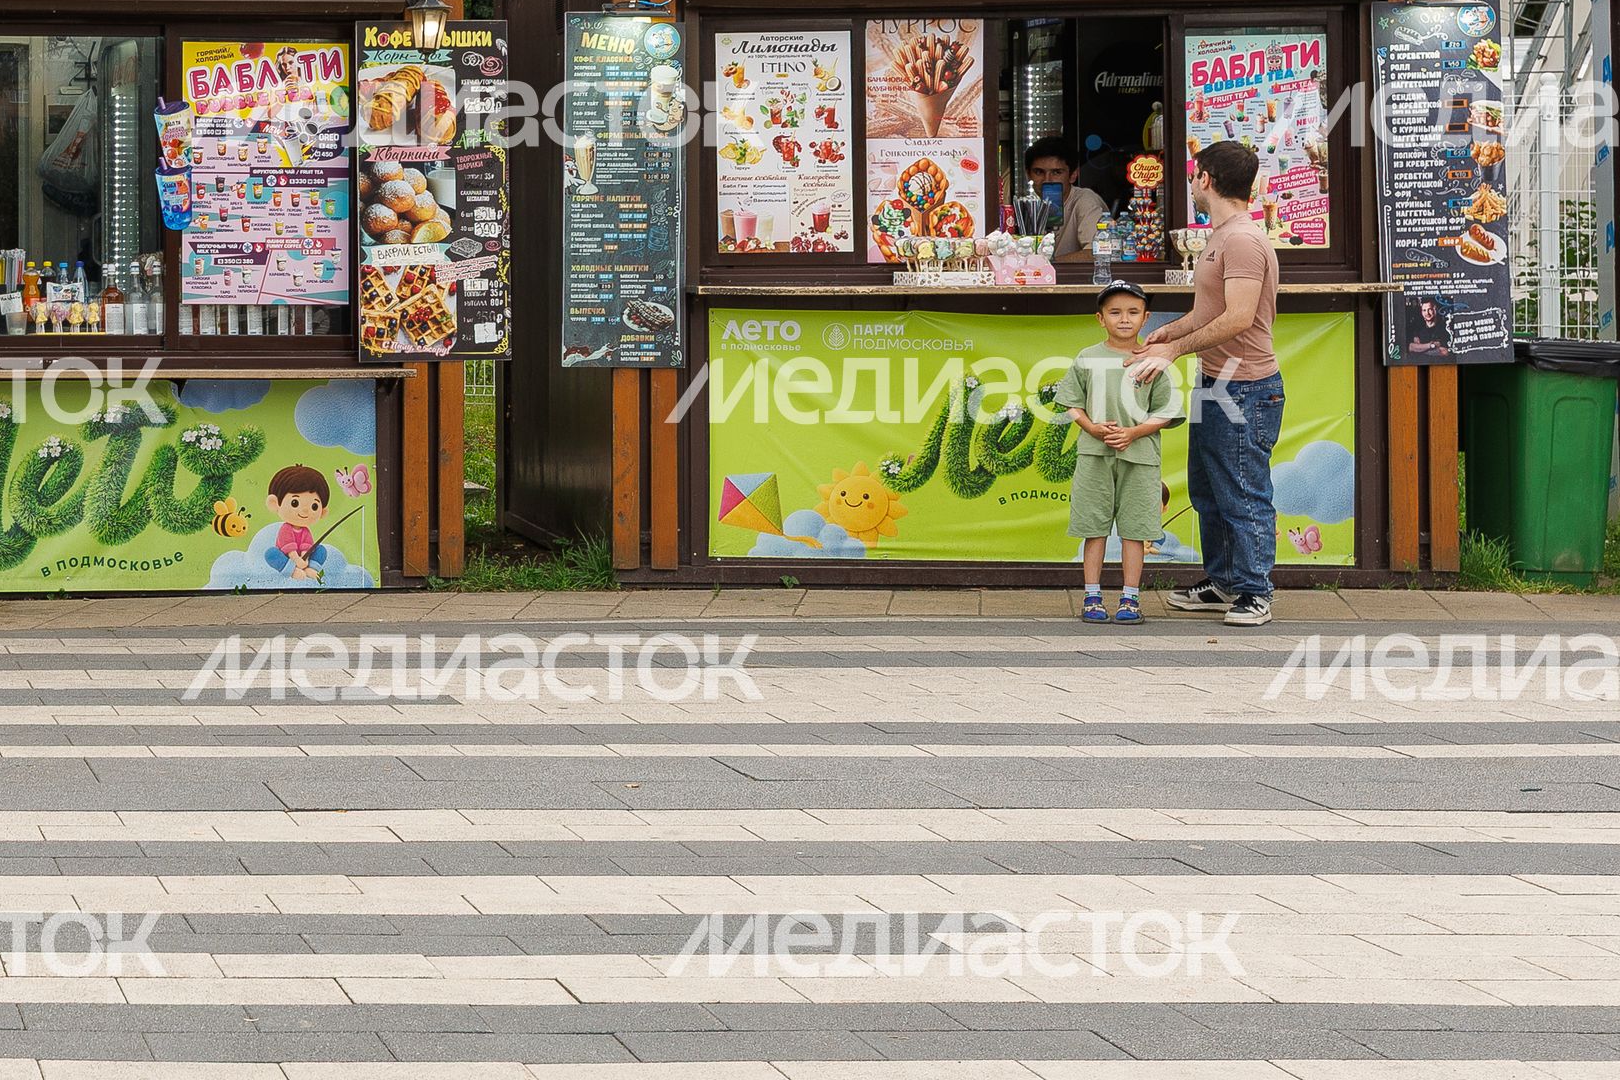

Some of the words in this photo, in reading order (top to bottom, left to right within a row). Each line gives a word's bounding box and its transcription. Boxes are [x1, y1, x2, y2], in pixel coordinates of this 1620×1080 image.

[442, 31, 492, 47] ЫШКИ
[581, 32, 635, 54] МЕНЮ
[732, 38, 837, 54] Лимонады
[1198, 45, 1232, 55] ХОЛОДНЫЙ
[195, 54, 234, 63] ХОЛОДНЫЙ
[1191, 50, 1265, 87] БАБЛ
[1281, 40, 1320, 68] ТИ
[190, 60, 279, 99] БАБЛ
[298, 50, 342, 82] ТИ
[1204, 74, 1262, 94] BUBBLE
[1267, 68, 1294, 82] TEA
[1213, 95, 1233, 103] FRUIT
[1392, 117, 1426, 125] СЕНДВИЧ
[263, 124, 282, 135] NEW
[456, 152, 493, 162] ТВОРОЖНЫЕ
[1393, 151, 1427, 159] ПОПКОРН
[457, 162, 483, 170] ШАРИКИ
[1134, 163, 1159, 172] Chupa
[1407, 159, 1444, 167] КРЕВЕТОК
[1133, 172, 1158, 183] Chups
[1394, 172, 1433, 180] КРЕВЕТКИ
[1292, 201, 1319, 211] COFFEE
[1403, 216, 1447, 225] КАРТОШКОЙ
[1396, 239, 1438, 247] КОРН-ДОГ
[378, 246, 411, 260] ВАФЛИ
[854, 324, 904, 335] ПАРКИ
[854, 338, 973, 351] ПОДМОСКОВЬЯ
[998, 496, 1007, 506] в
[41, 567, 51, 577] в
[57, 551, 184, 570] подмосковье
